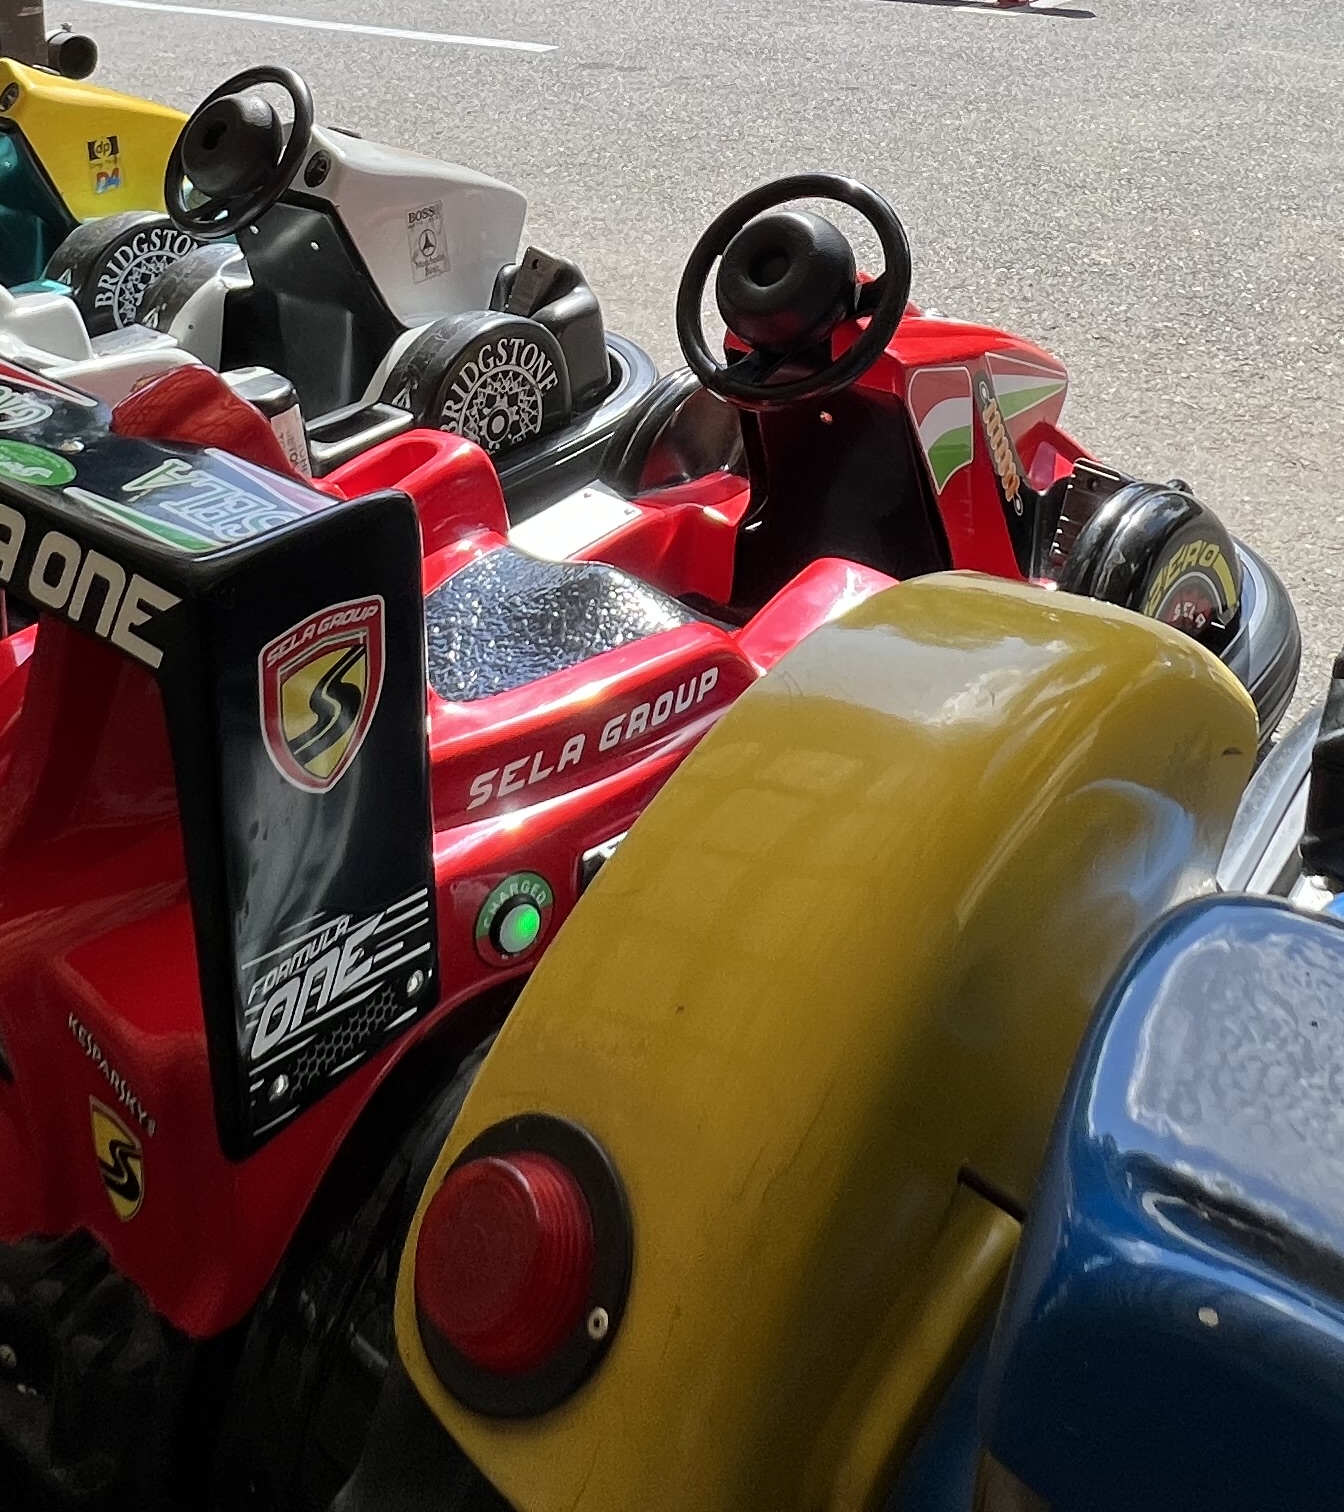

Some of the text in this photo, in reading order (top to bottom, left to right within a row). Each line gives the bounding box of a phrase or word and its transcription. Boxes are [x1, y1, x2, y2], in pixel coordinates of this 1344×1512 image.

[28, 530, 183, 669] ONE
[266, 605, 379, 668] SELA GROUP
[466, 667, 719, 811] SELA GROUP
[248, 914, 352, 1005] FORMULA
[483, 879, 547, 930] CHARGED
[251, 911, 386, 1061] ONE
